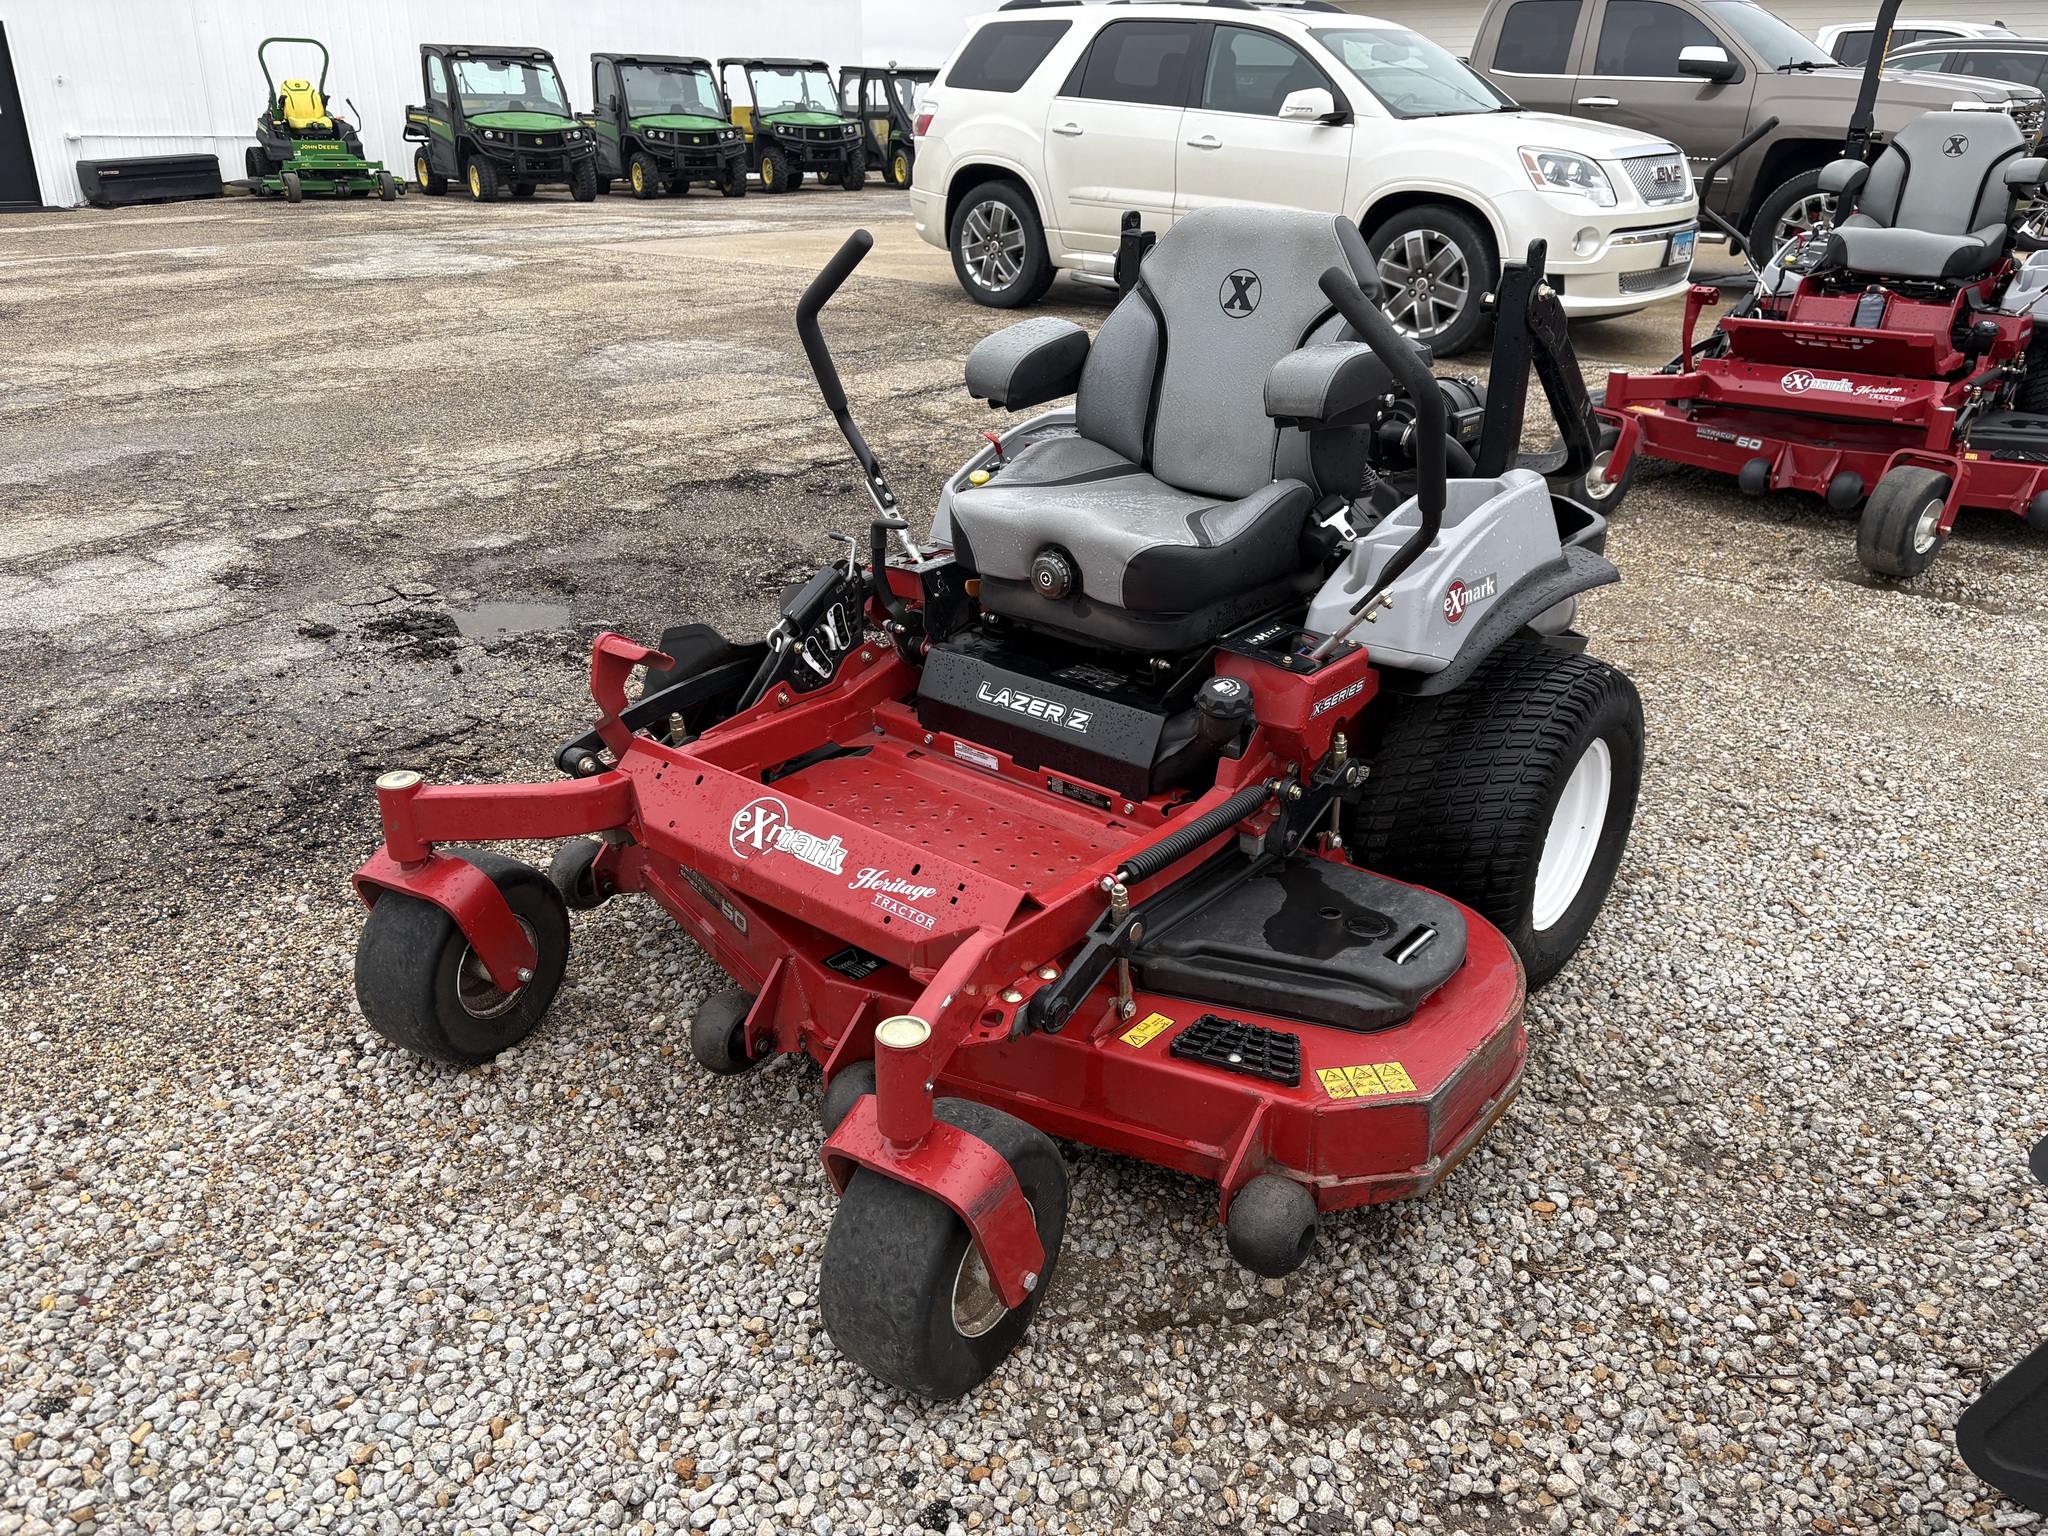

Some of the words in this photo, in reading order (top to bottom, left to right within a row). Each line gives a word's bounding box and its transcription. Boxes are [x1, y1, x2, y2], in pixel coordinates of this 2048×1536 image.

[1655, 165, 1682, 183] GMC
[1222, 273, 1258, 312] X
[1853, 385, 1903, 396] Heritage
[1867, 393, 1907, 402] TRACTOR
[1736, 436, 1763, 451] 60
[977, 681, 1067, 726] LAZER
[1064, 708, 1093, 733] Z
[1311, 679, 1366, 717] X-SERIES
[848, 867, 938, 901] Heritage
[721, 897, 747, 934] 60
[872, 892, 936, 930] TRACTOR
